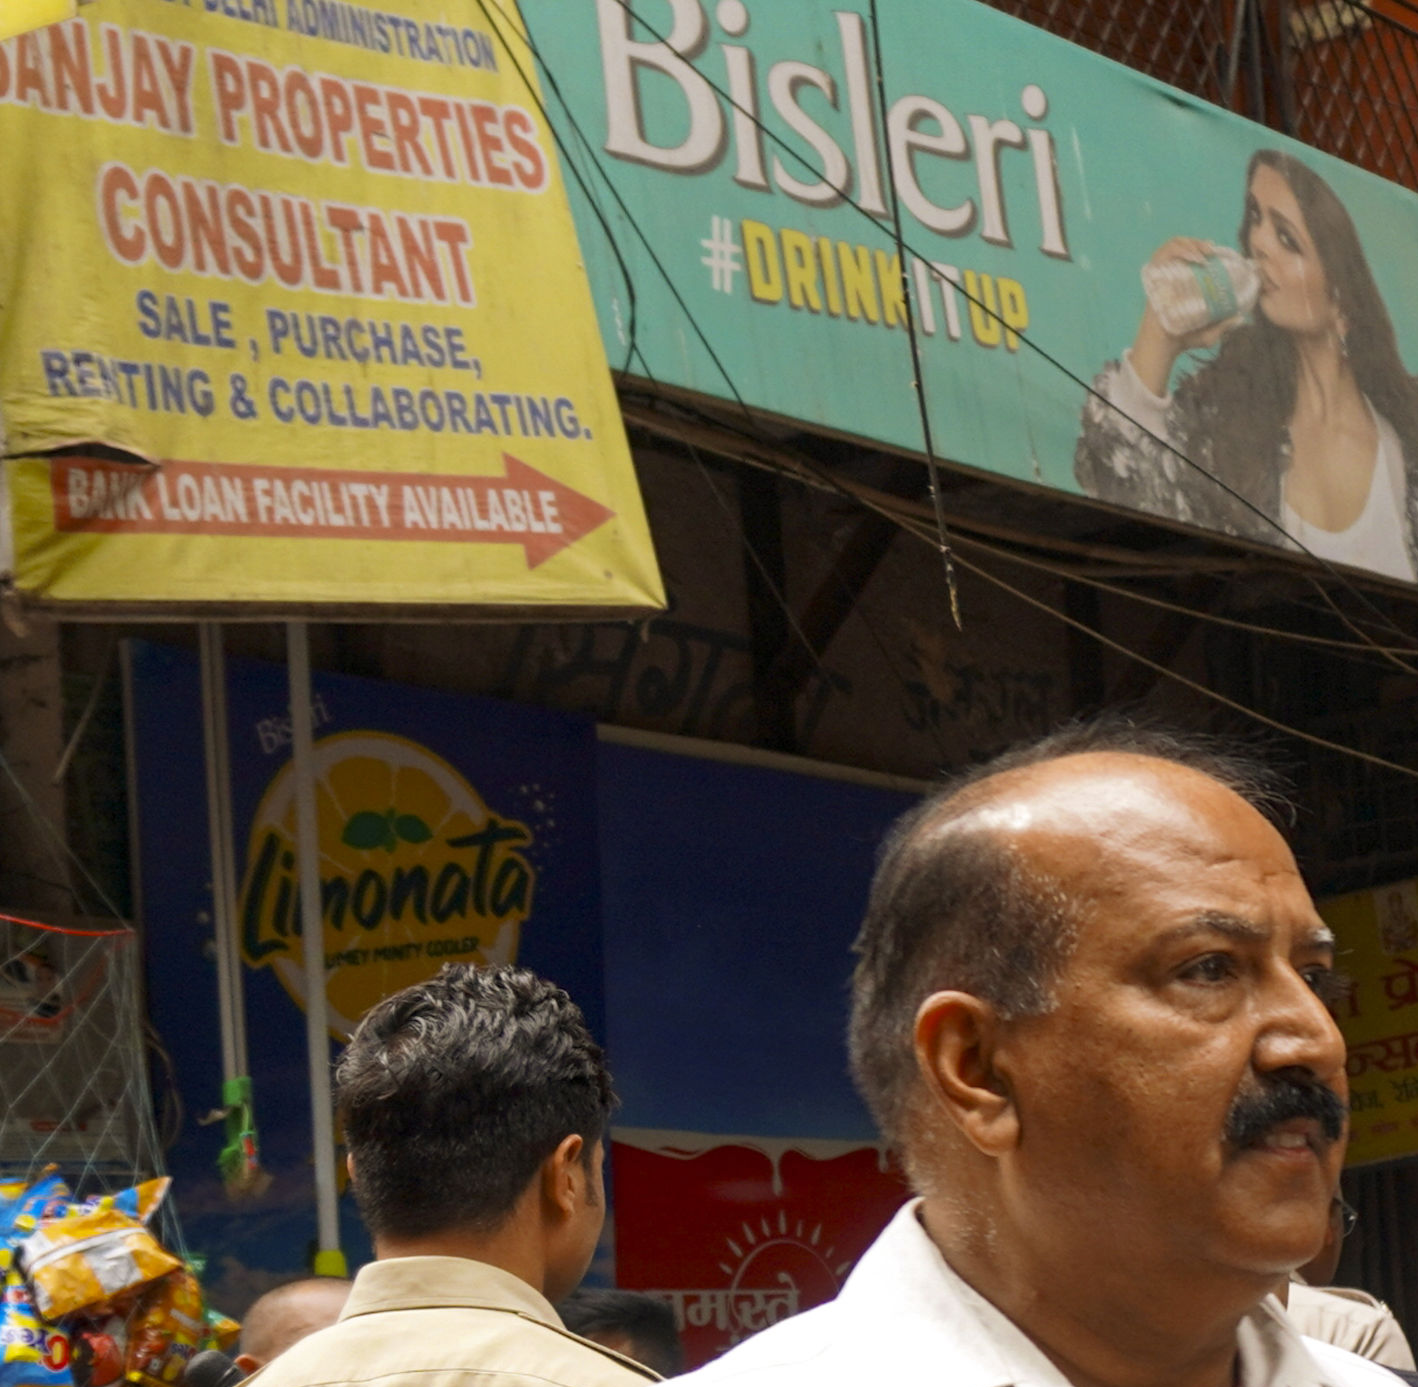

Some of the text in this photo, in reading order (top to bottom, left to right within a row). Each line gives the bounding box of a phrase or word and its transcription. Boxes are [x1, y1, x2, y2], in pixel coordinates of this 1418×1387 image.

[288, 2, 498, 72] ADMINISTRATION
[0, 20, 546, 189] ANJAY PROPERTIES
[596, 0, 1072, 260] Bisleri
[103, 166, 471, 302] CONSULTANT
[137, 291, 236, 348] SALE
[266, 309, 482, 379] PURCHASE,
[42, 351, 593, 440] RENTING & COLLABORATING.
[68, 468, 564, 534] BANK LOAN FACILITY AVAILABLE
